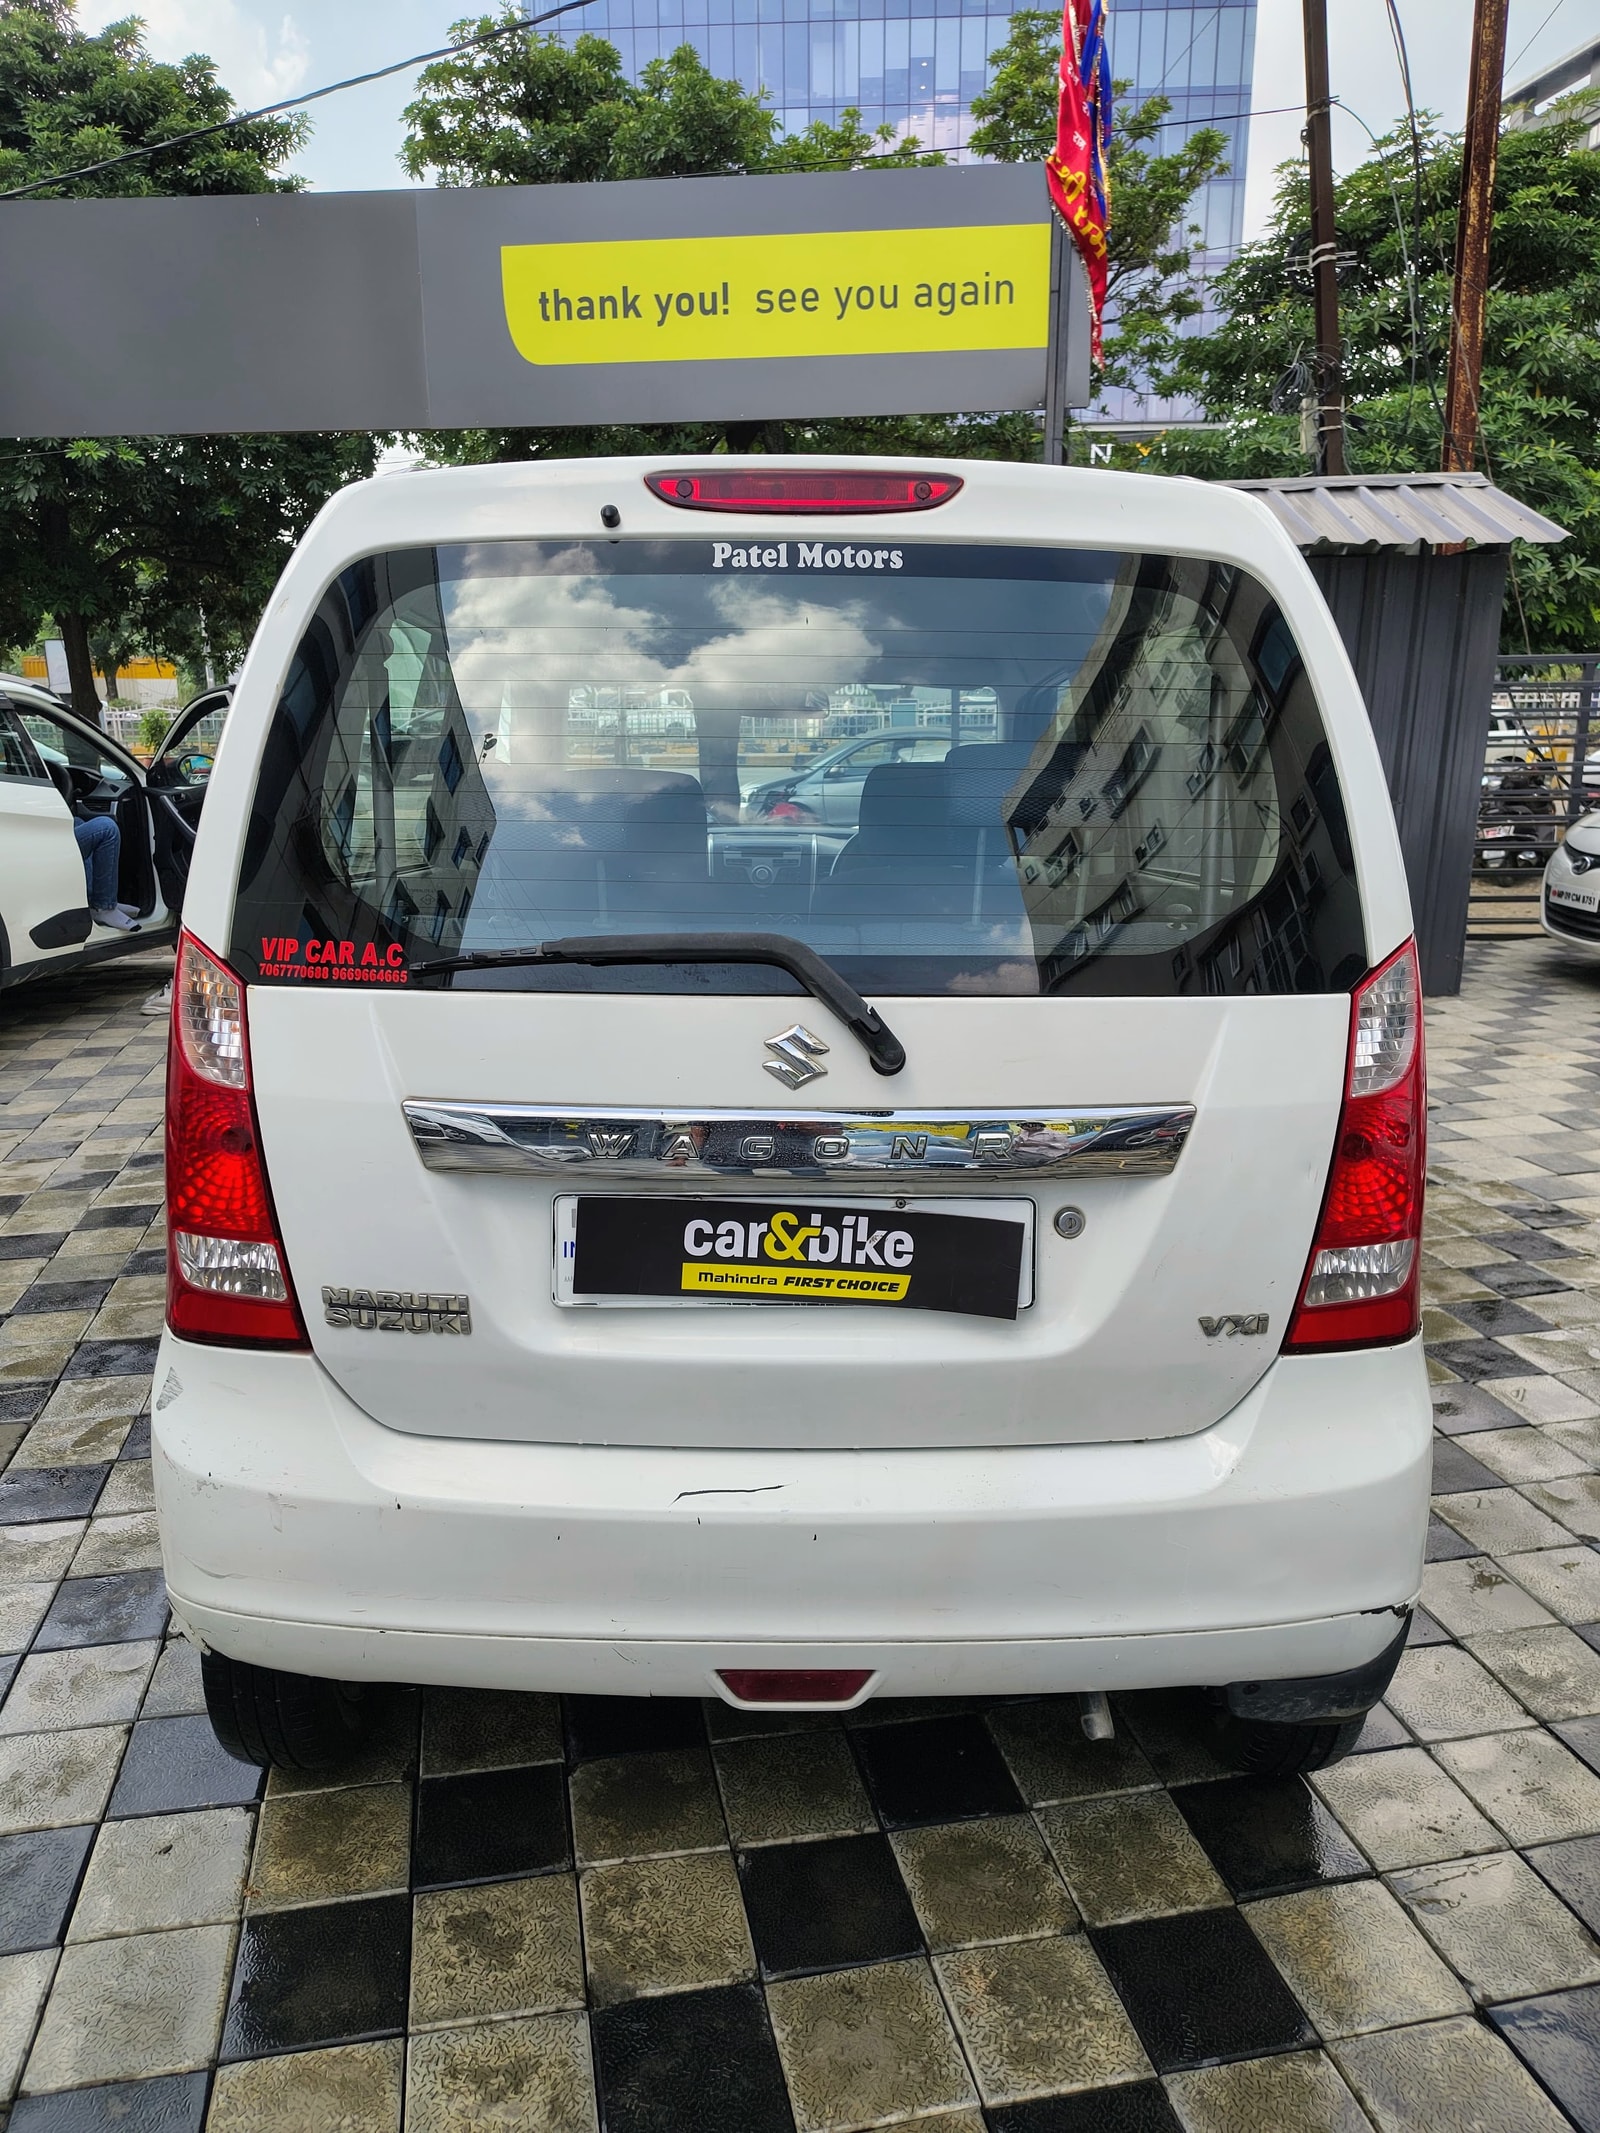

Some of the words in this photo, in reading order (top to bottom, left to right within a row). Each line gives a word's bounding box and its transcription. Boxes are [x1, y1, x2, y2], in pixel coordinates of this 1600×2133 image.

[539, 285, 643, 322] thank
[653, 281, 729, 327] you!
[755, 287, 820, 314] see
[833, 283, 899, 321] you
[914, 271, 1015, 316] again
[712, 542, 789, 568] Patel
[797, 542, 904, 569] Motors
[261, 937, 299, 962] VIP
[305, 939, 355, 965] CAR
[360, 942, 404, 967] A.C
[259, 962, 329, 979] 7067770688
[332, 967, 408, 983] 9669664665
[698, 1271, 778, 1286] Mahindra
[783, 1276, 835, 1290] FIRST
[836, 1279, 900, 1293] CHOICE
[321, 1286, 469, 1312] MARUTI
[325, 1307, 472, 1335] SUZUKI
